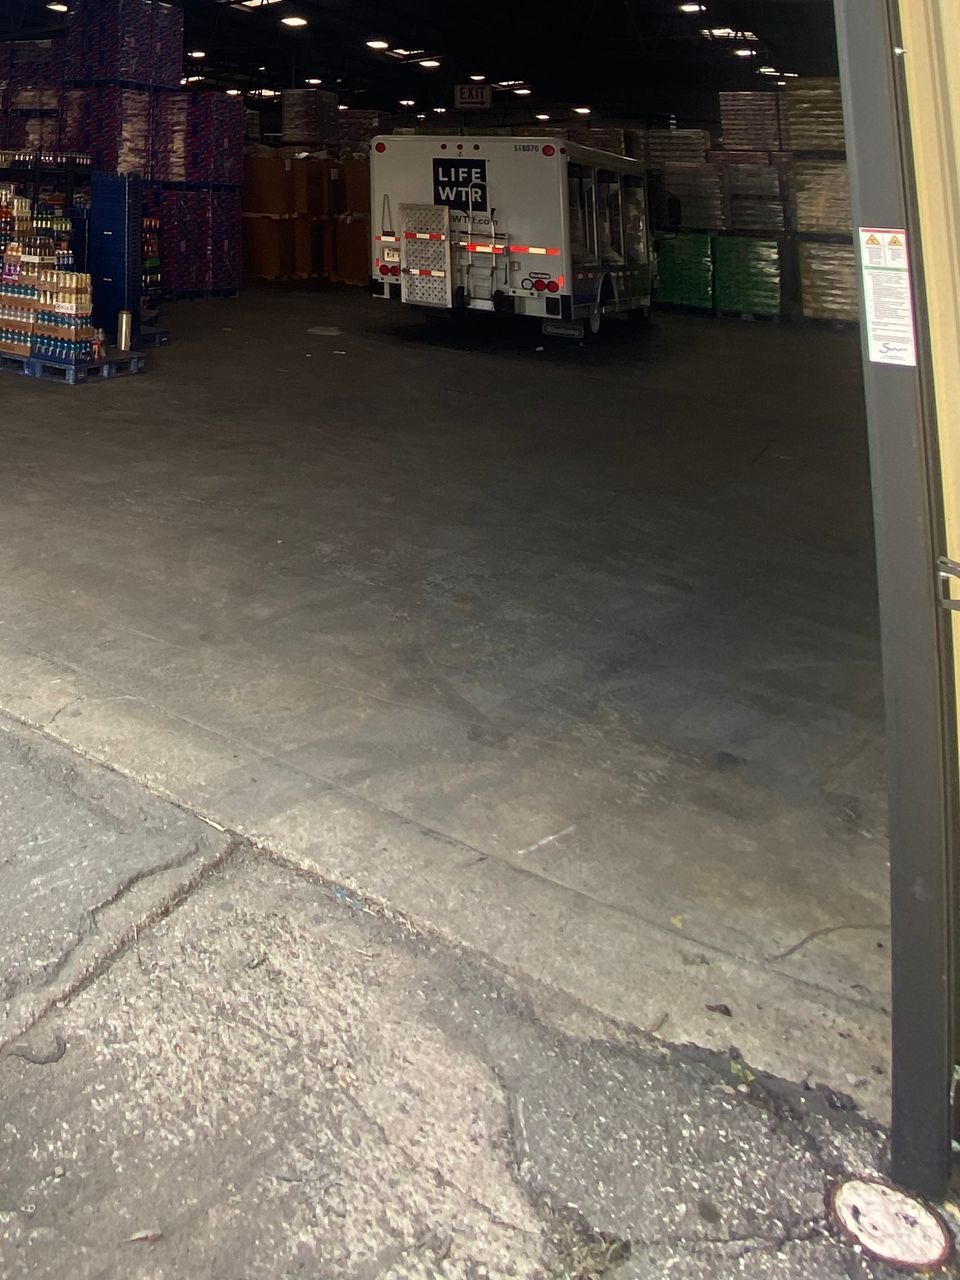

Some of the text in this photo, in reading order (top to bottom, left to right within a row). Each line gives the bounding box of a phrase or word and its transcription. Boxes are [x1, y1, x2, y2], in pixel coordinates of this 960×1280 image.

[460, 87, 484, 100] EXIT
[438, 167, 481, 182] LIFE
[438, 186, 482, 202] WTR
